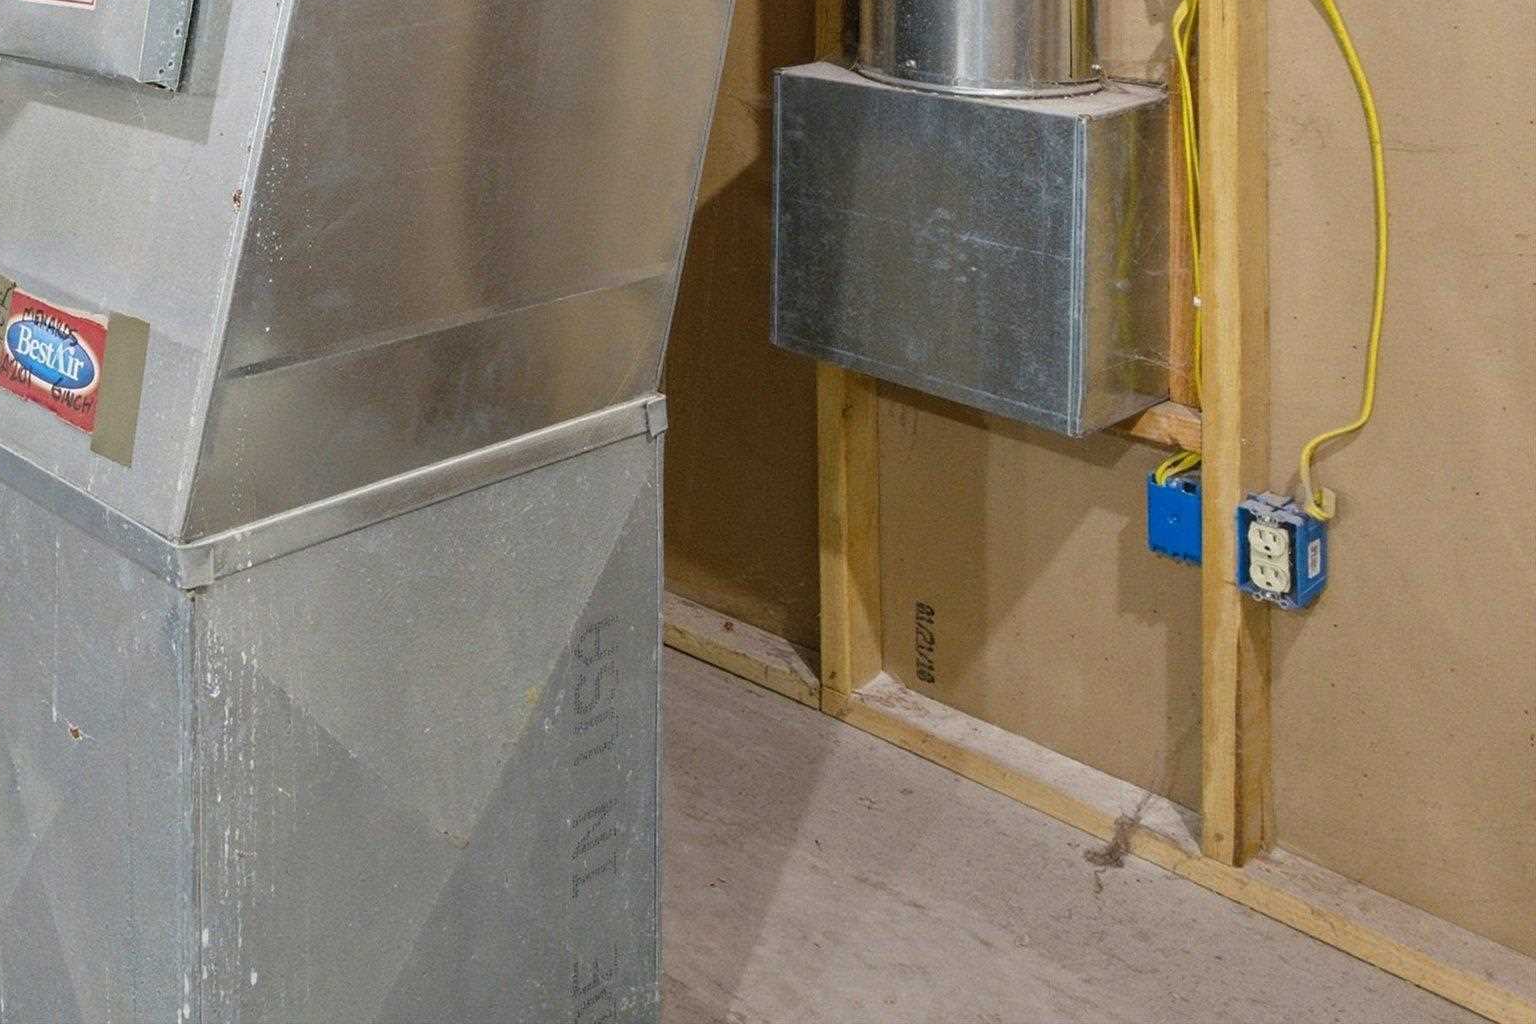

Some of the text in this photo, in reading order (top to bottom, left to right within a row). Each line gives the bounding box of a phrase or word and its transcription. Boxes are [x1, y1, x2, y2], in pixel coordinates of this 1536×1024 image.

[15, 325, 84, 381] BestAir
[572, 615, 622, 767] USA
[571, 798, 621, 903] IN
